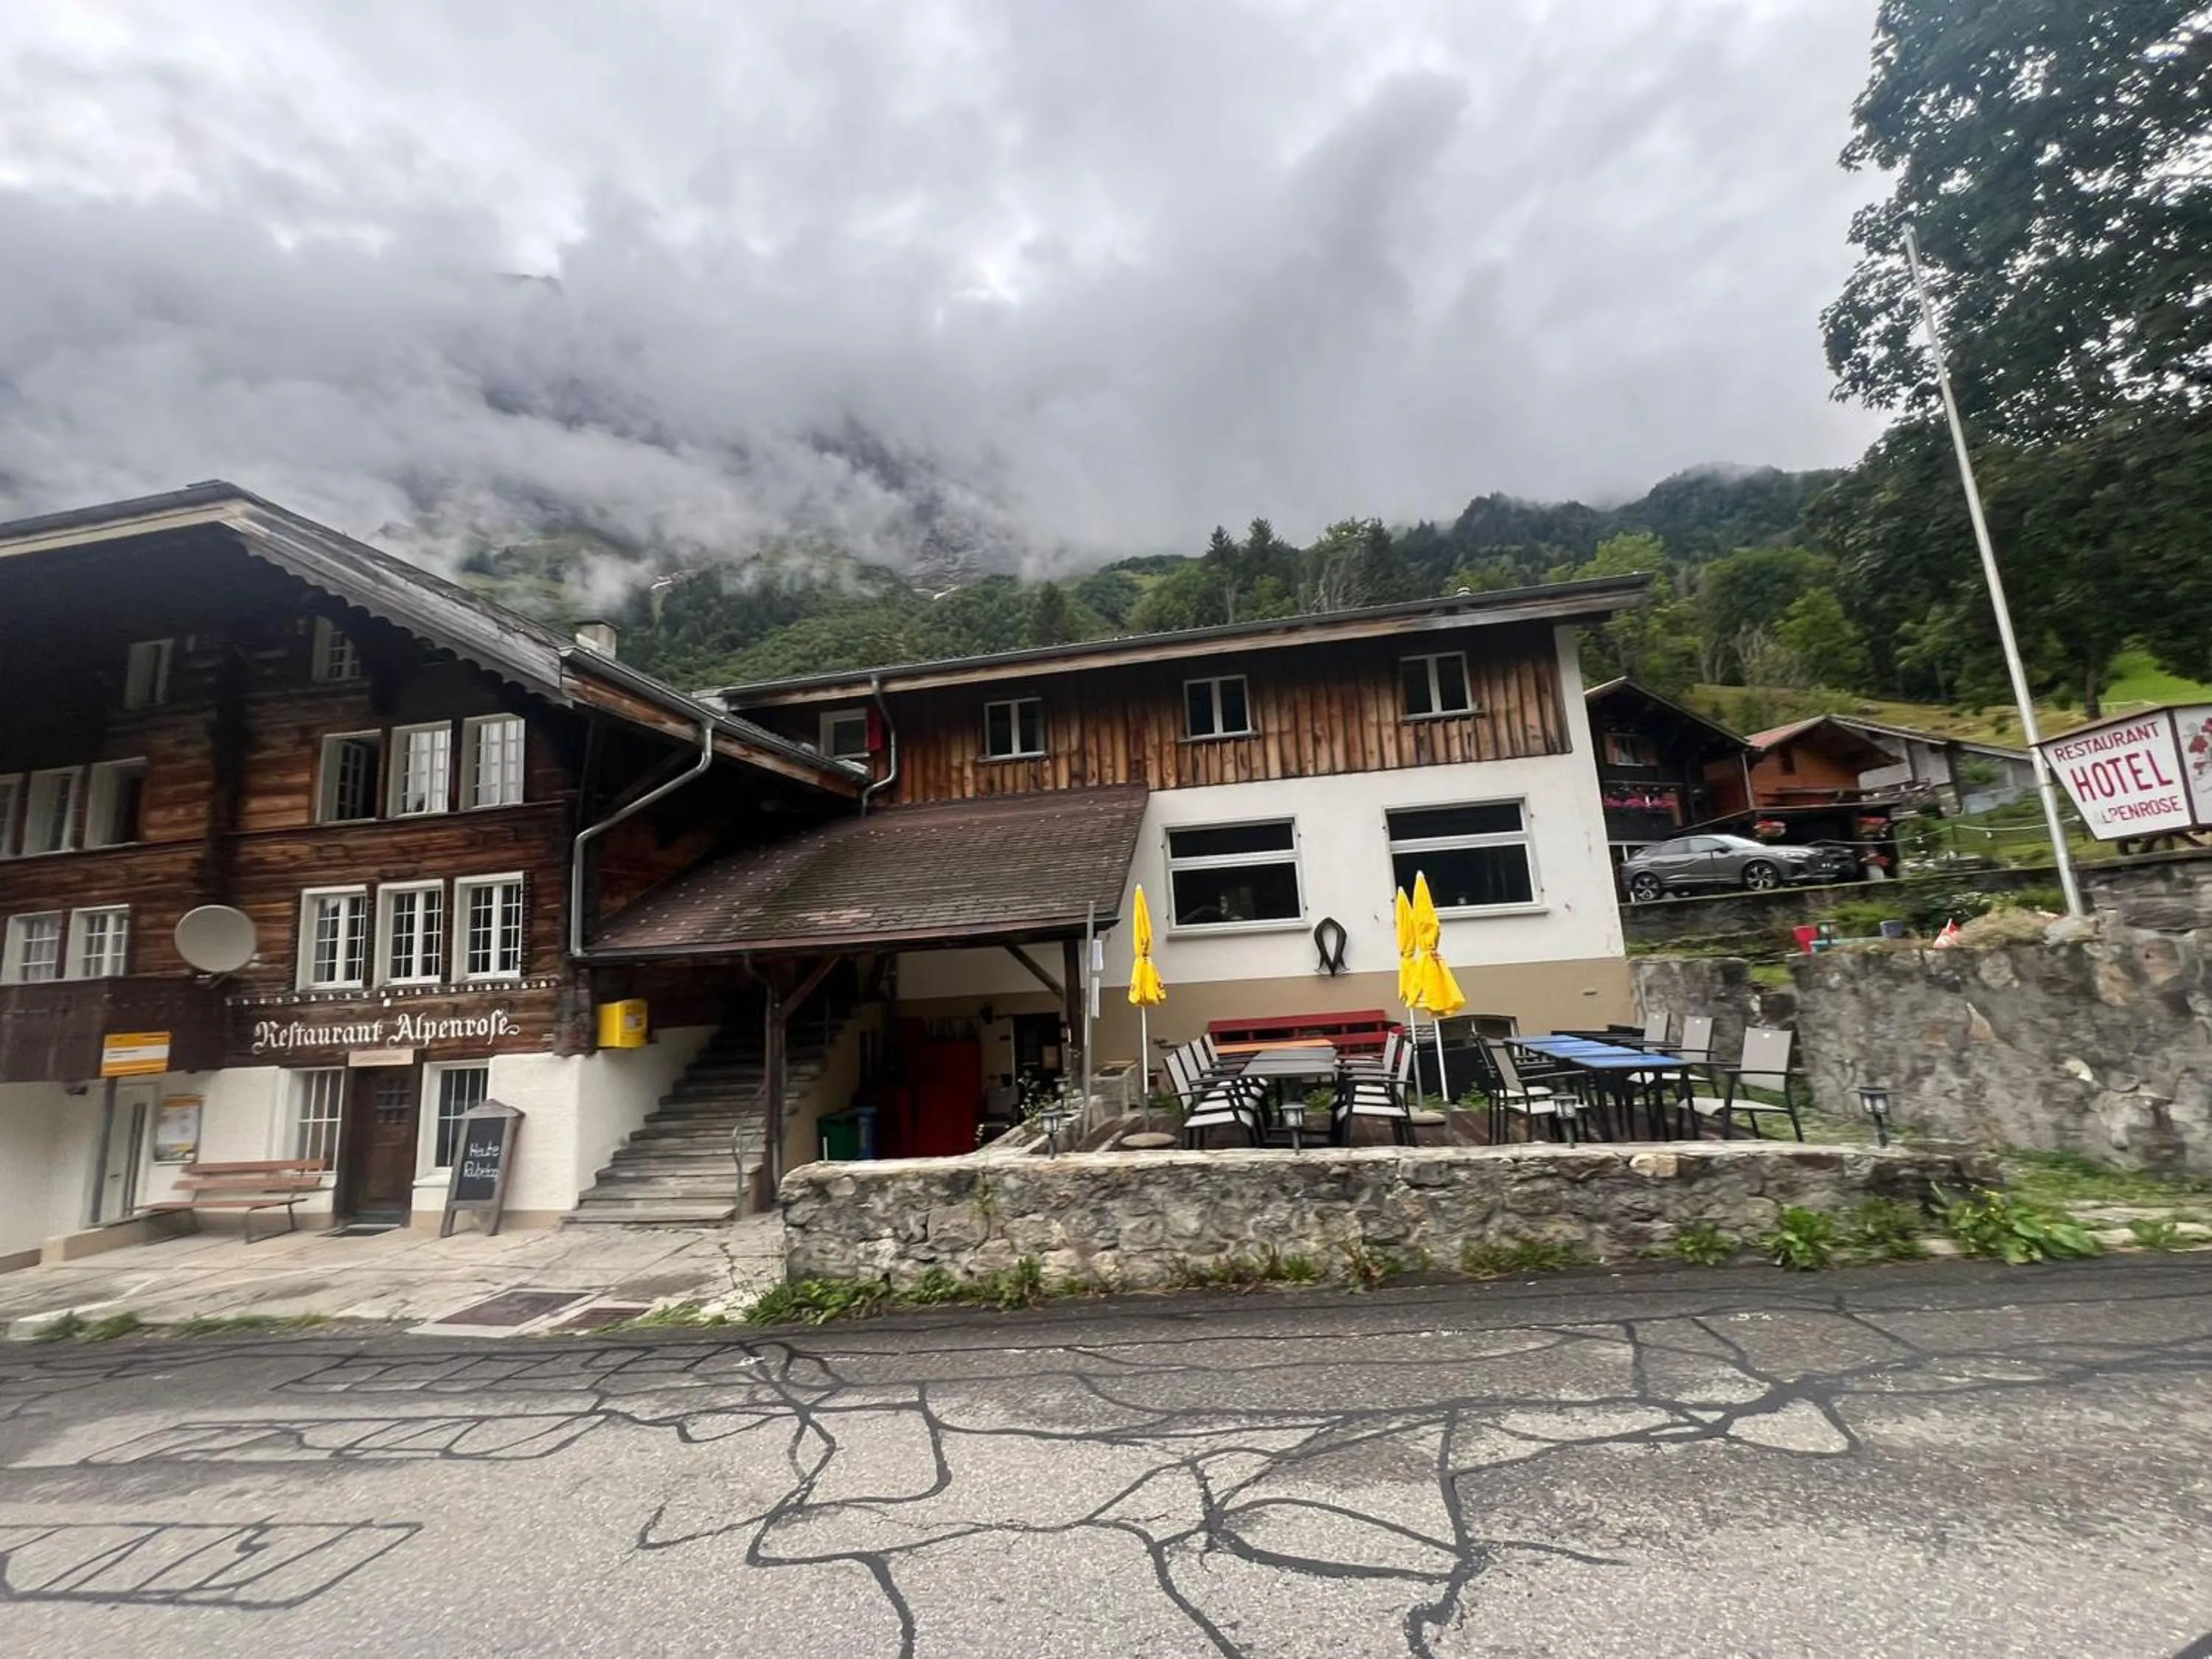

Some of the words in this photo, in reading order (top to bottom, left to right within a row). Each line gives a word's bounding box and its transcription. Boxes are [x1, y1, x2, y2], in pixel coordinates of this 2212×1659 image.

[2053, 720, 2160, 762] RESTAURANT
[2069, 749, 2174, 803] HOTEL
[2095, 796, 2183, 824] LPENROSE
